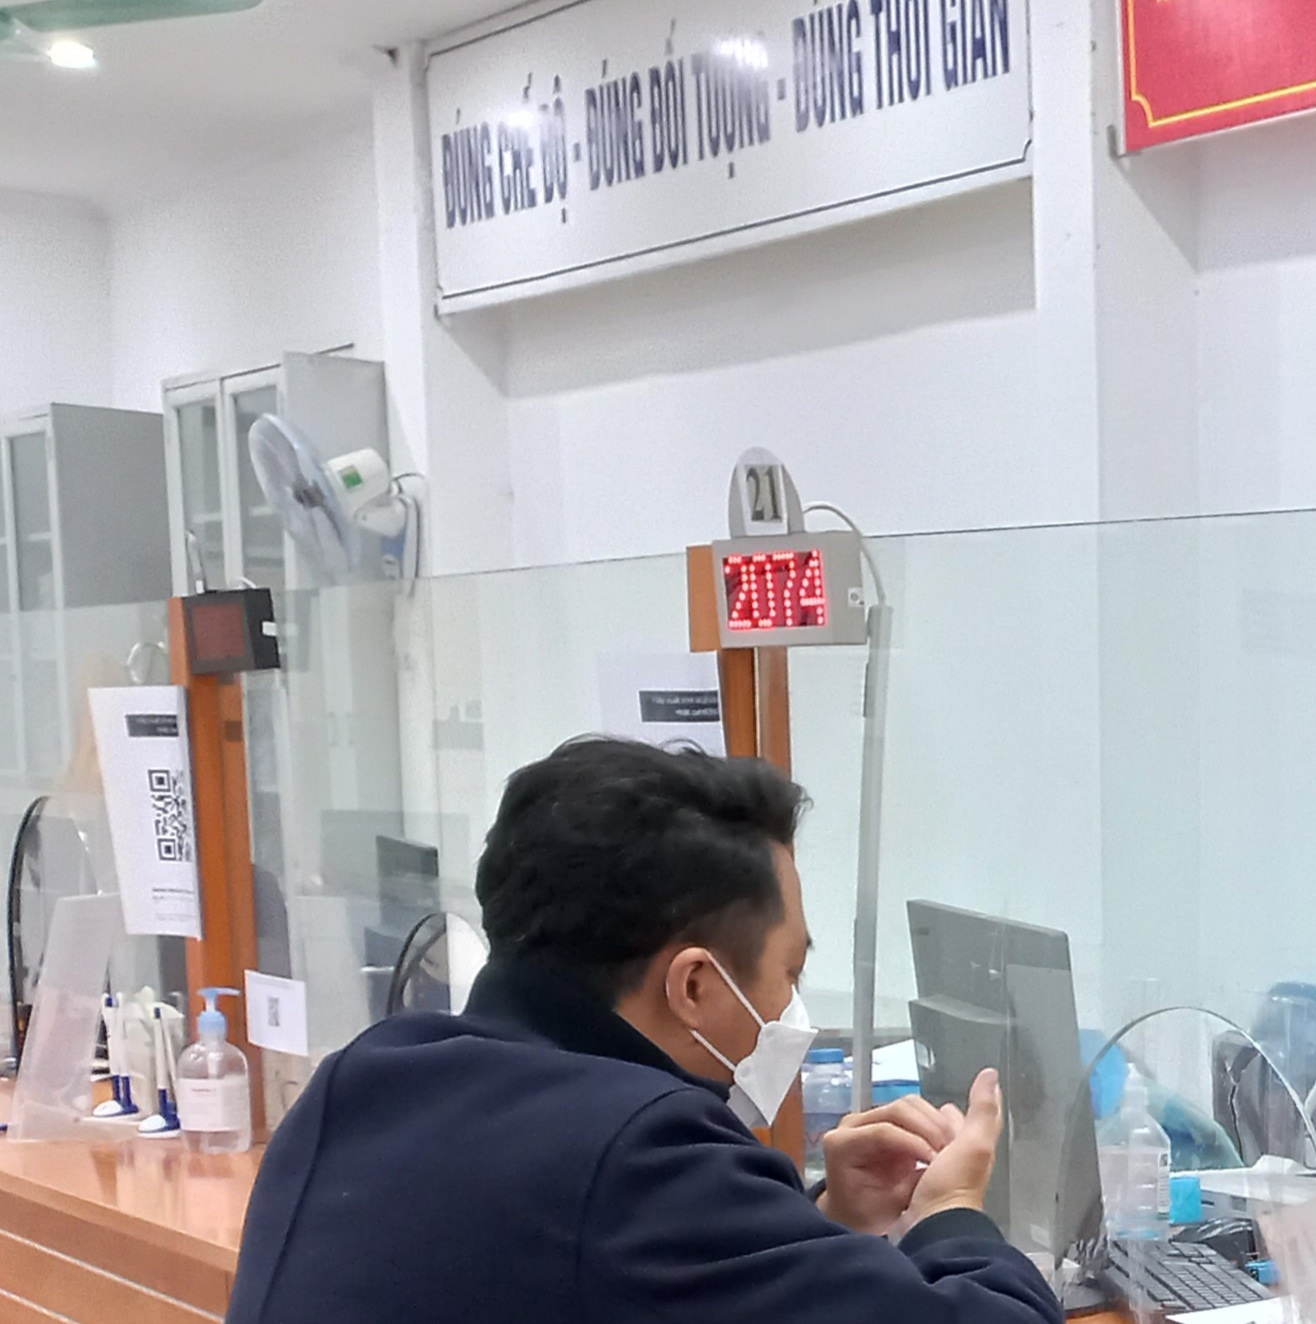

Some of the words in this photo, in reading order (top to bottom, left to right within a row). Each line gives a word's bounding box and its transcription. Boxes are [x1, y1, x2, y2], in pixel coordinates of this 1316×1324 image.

[585, 59, 645, 191] ĐÚNG
[746, 464, 783, 522] 21
[724, 549, 826, 628] 2074
